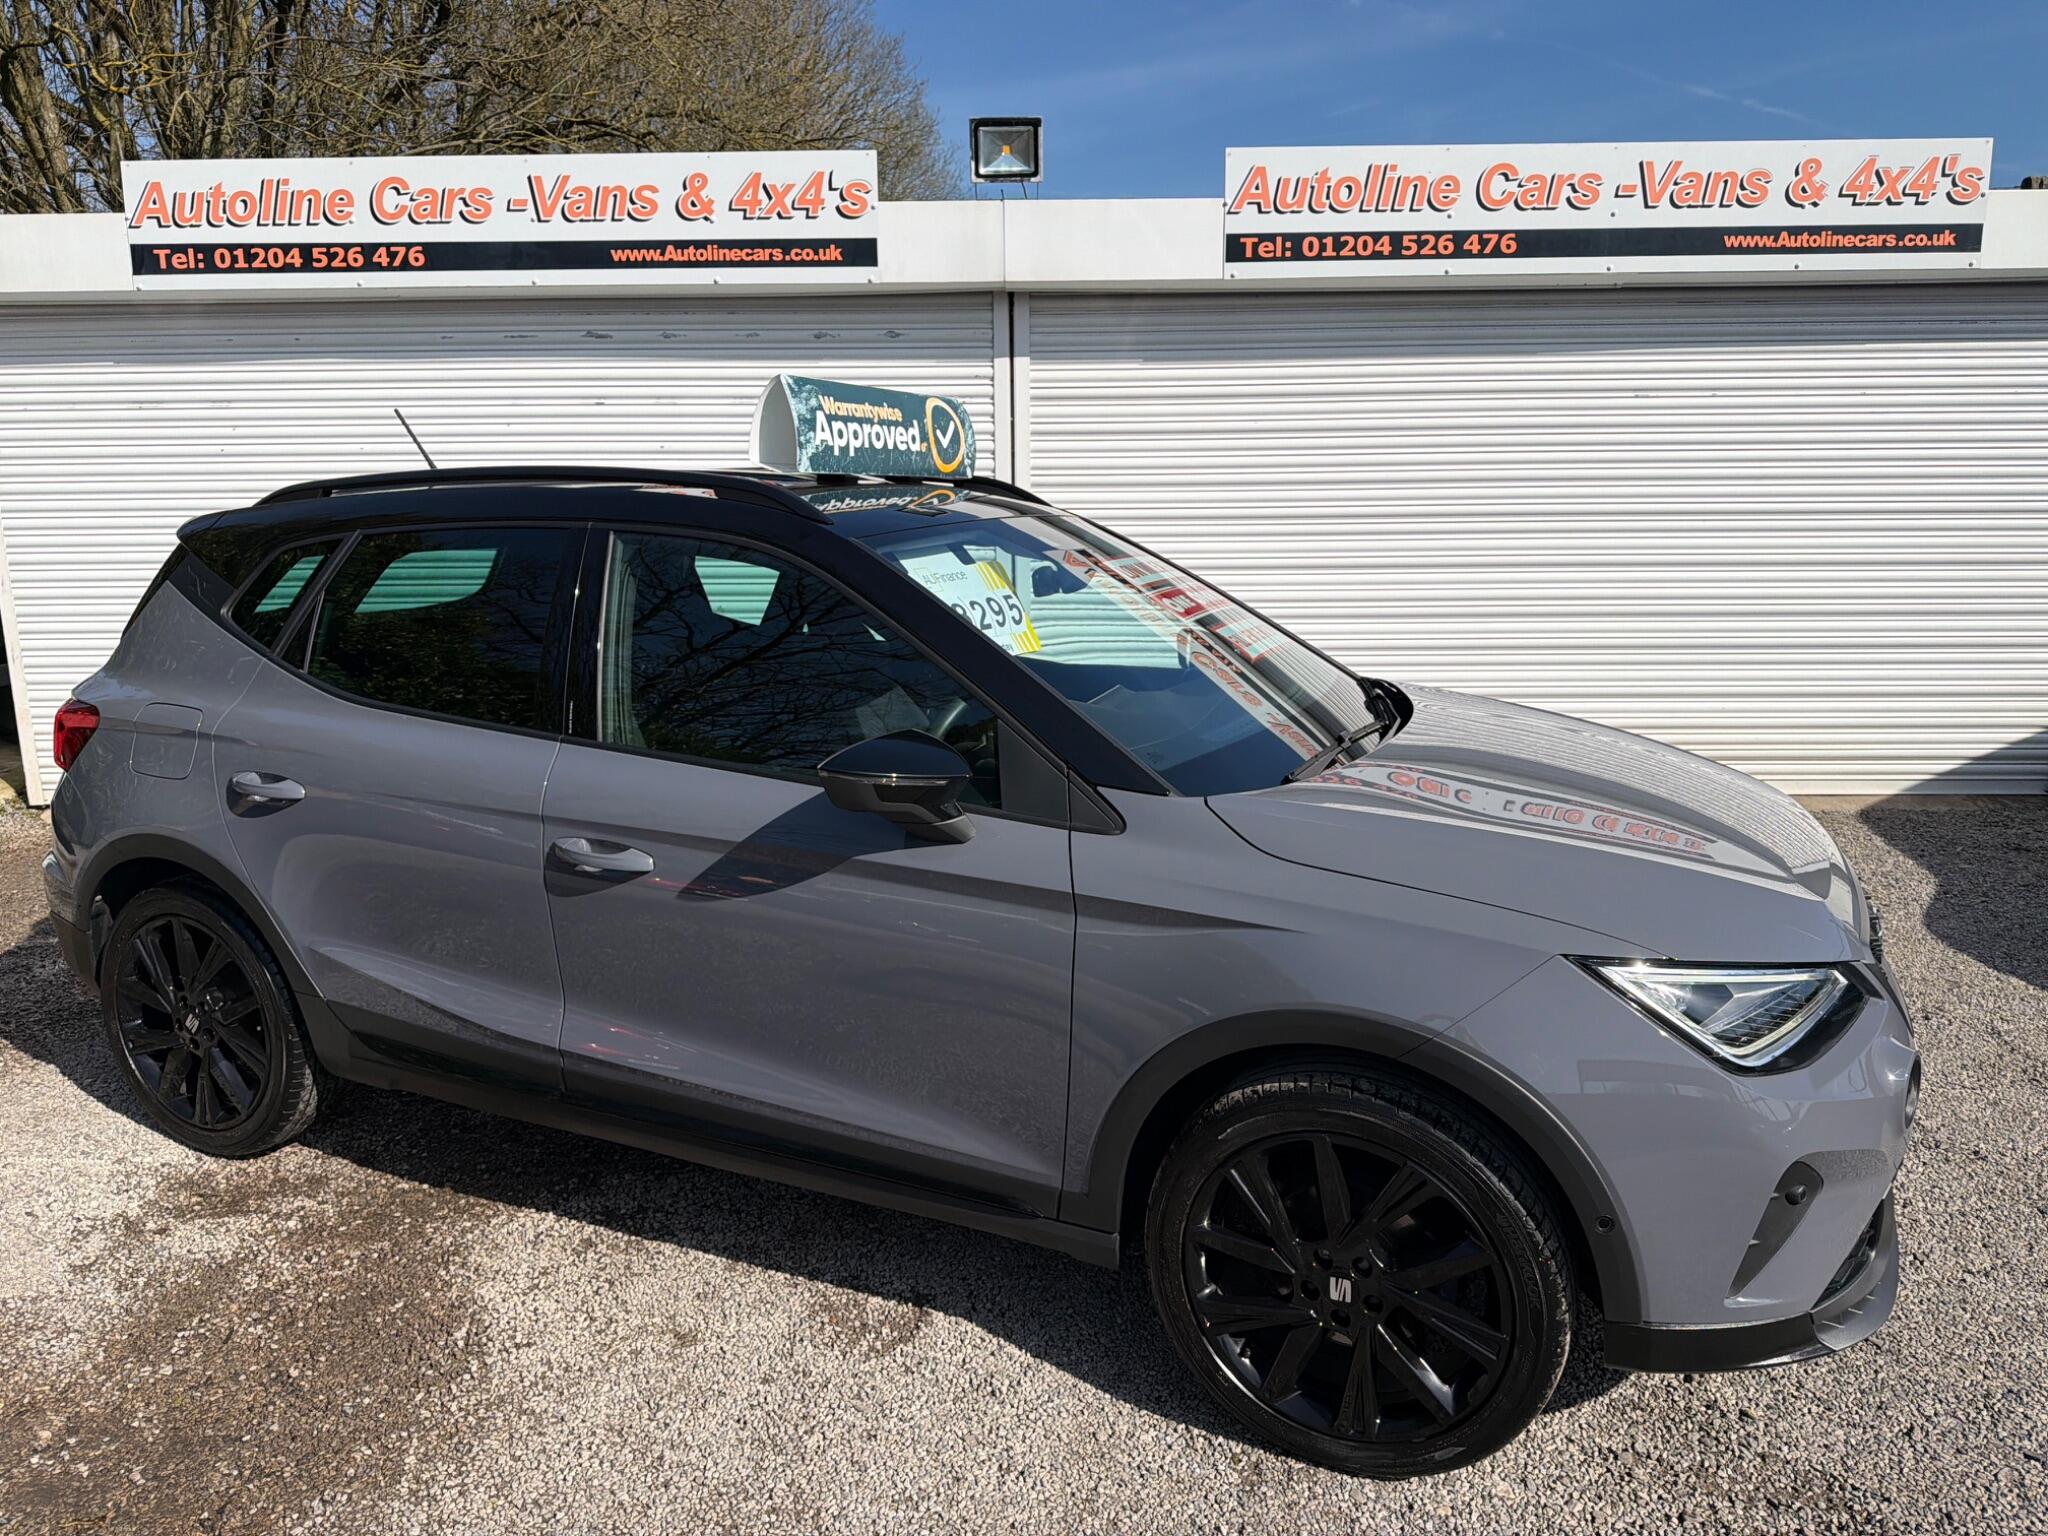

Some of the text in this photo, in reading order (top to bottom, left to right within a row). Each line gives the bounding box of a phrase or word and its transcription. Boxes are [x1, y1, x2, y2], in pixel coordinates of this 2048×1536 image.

[1227, 162, 1462, 214] Autoline
[1476, 162, 1603, 212] Cars
[1784, 157, 1828, 208] &
[1838, 153, 1985, 206] 4x4's
[128, 176, 355, 229] Autoline
[369, 176, 495, 224] Cars
[675, 171, 717, 223] &
[728, 168, 873, 220] 4x4's
[1239, 232, 1518, 258] Tel: 01204 526 476
[1723, 229, 1957, 248] www.Autolinecars.co.uk
[153, 246, 426, 270] Tel: 01204 526 476
[610, 244, 843, 263] www.Autolinecars.co.uk
[818, 394, 904, 423] Warrantywise
